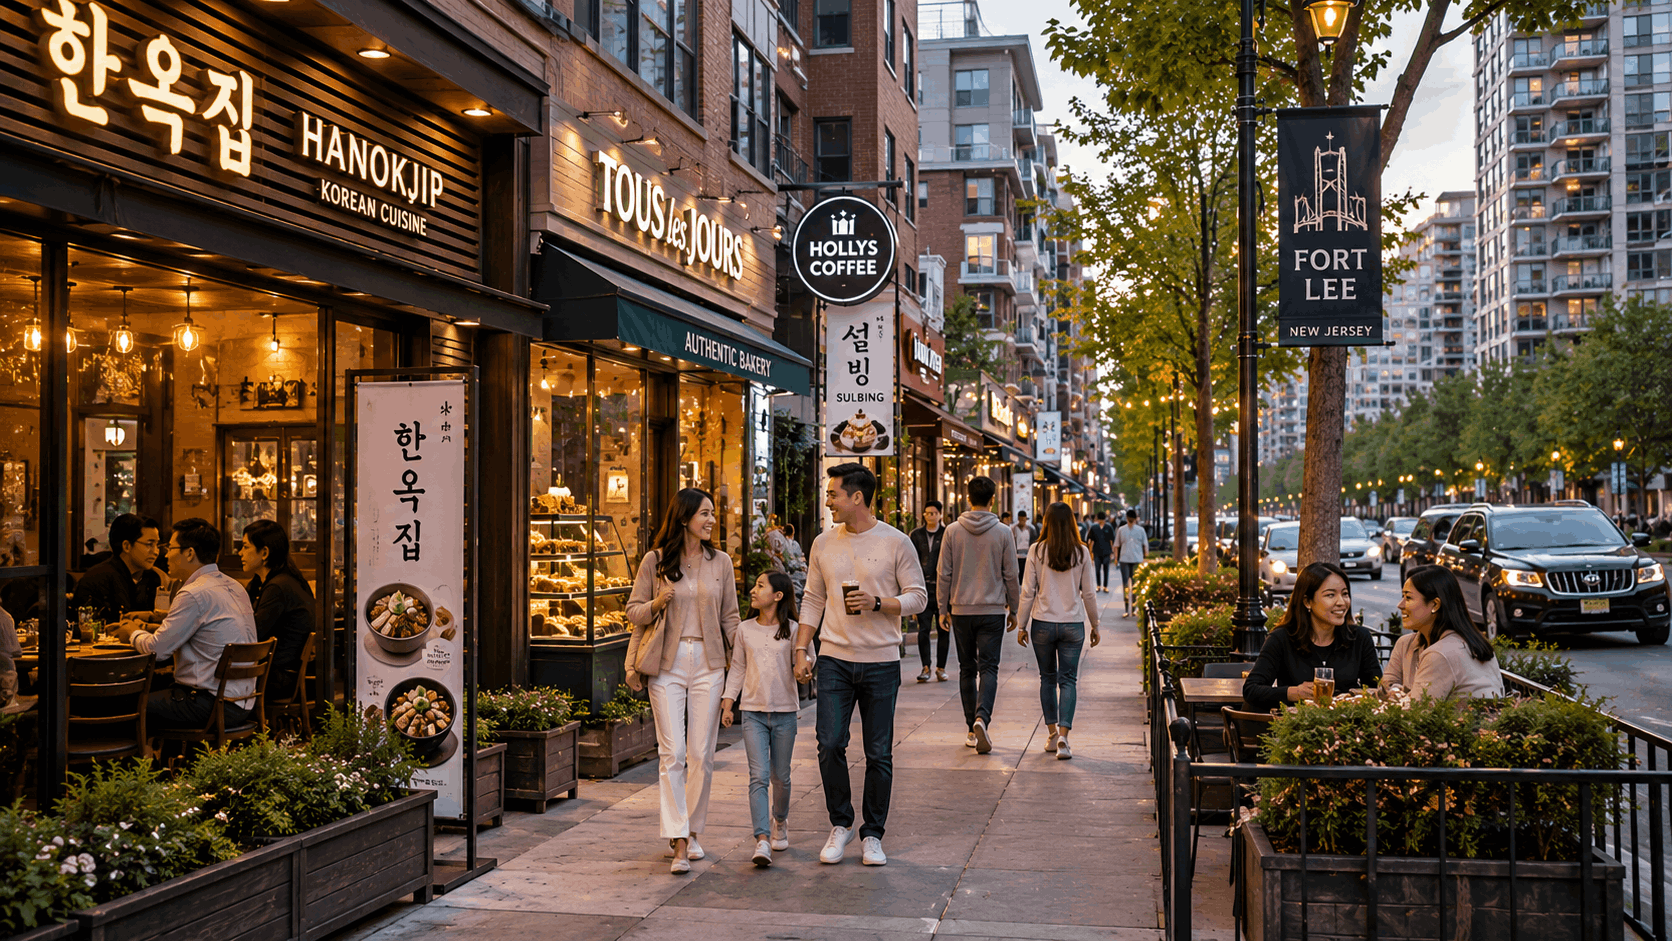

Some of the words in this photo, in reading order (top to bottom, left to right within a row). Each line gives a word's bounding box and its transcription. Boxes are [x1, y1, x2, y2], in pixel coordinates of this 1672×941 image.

[41, 0, 254, 178] 한옥집
[301, 111, 444, 208] HANOKJIP
[321, 178, 377, 218] KOREAN
[380, 205, 427, 237] CUISINE
[598, 150, 664, 240] TOUS
[666, 197, 687, 251] les
[686, 208, 743, 281] JOURS
[809, 239, 879, 257] HOLLYS
[1294, 248, 1368, 271] FORT
[809, 259, 877, 276] COFFEE
[1305, 277, 1357, 300] LEE
[1289, 325, 1320, 337] NEW
[1324, 325, 1373, 337] JERSEY
[684, 331, 737, 368] AUTHENTIC
[739, 347, 771, 378] BAKERY
[836, 392, 885, 403] SULBING
[392, 420, 427, 562] 한옥집
